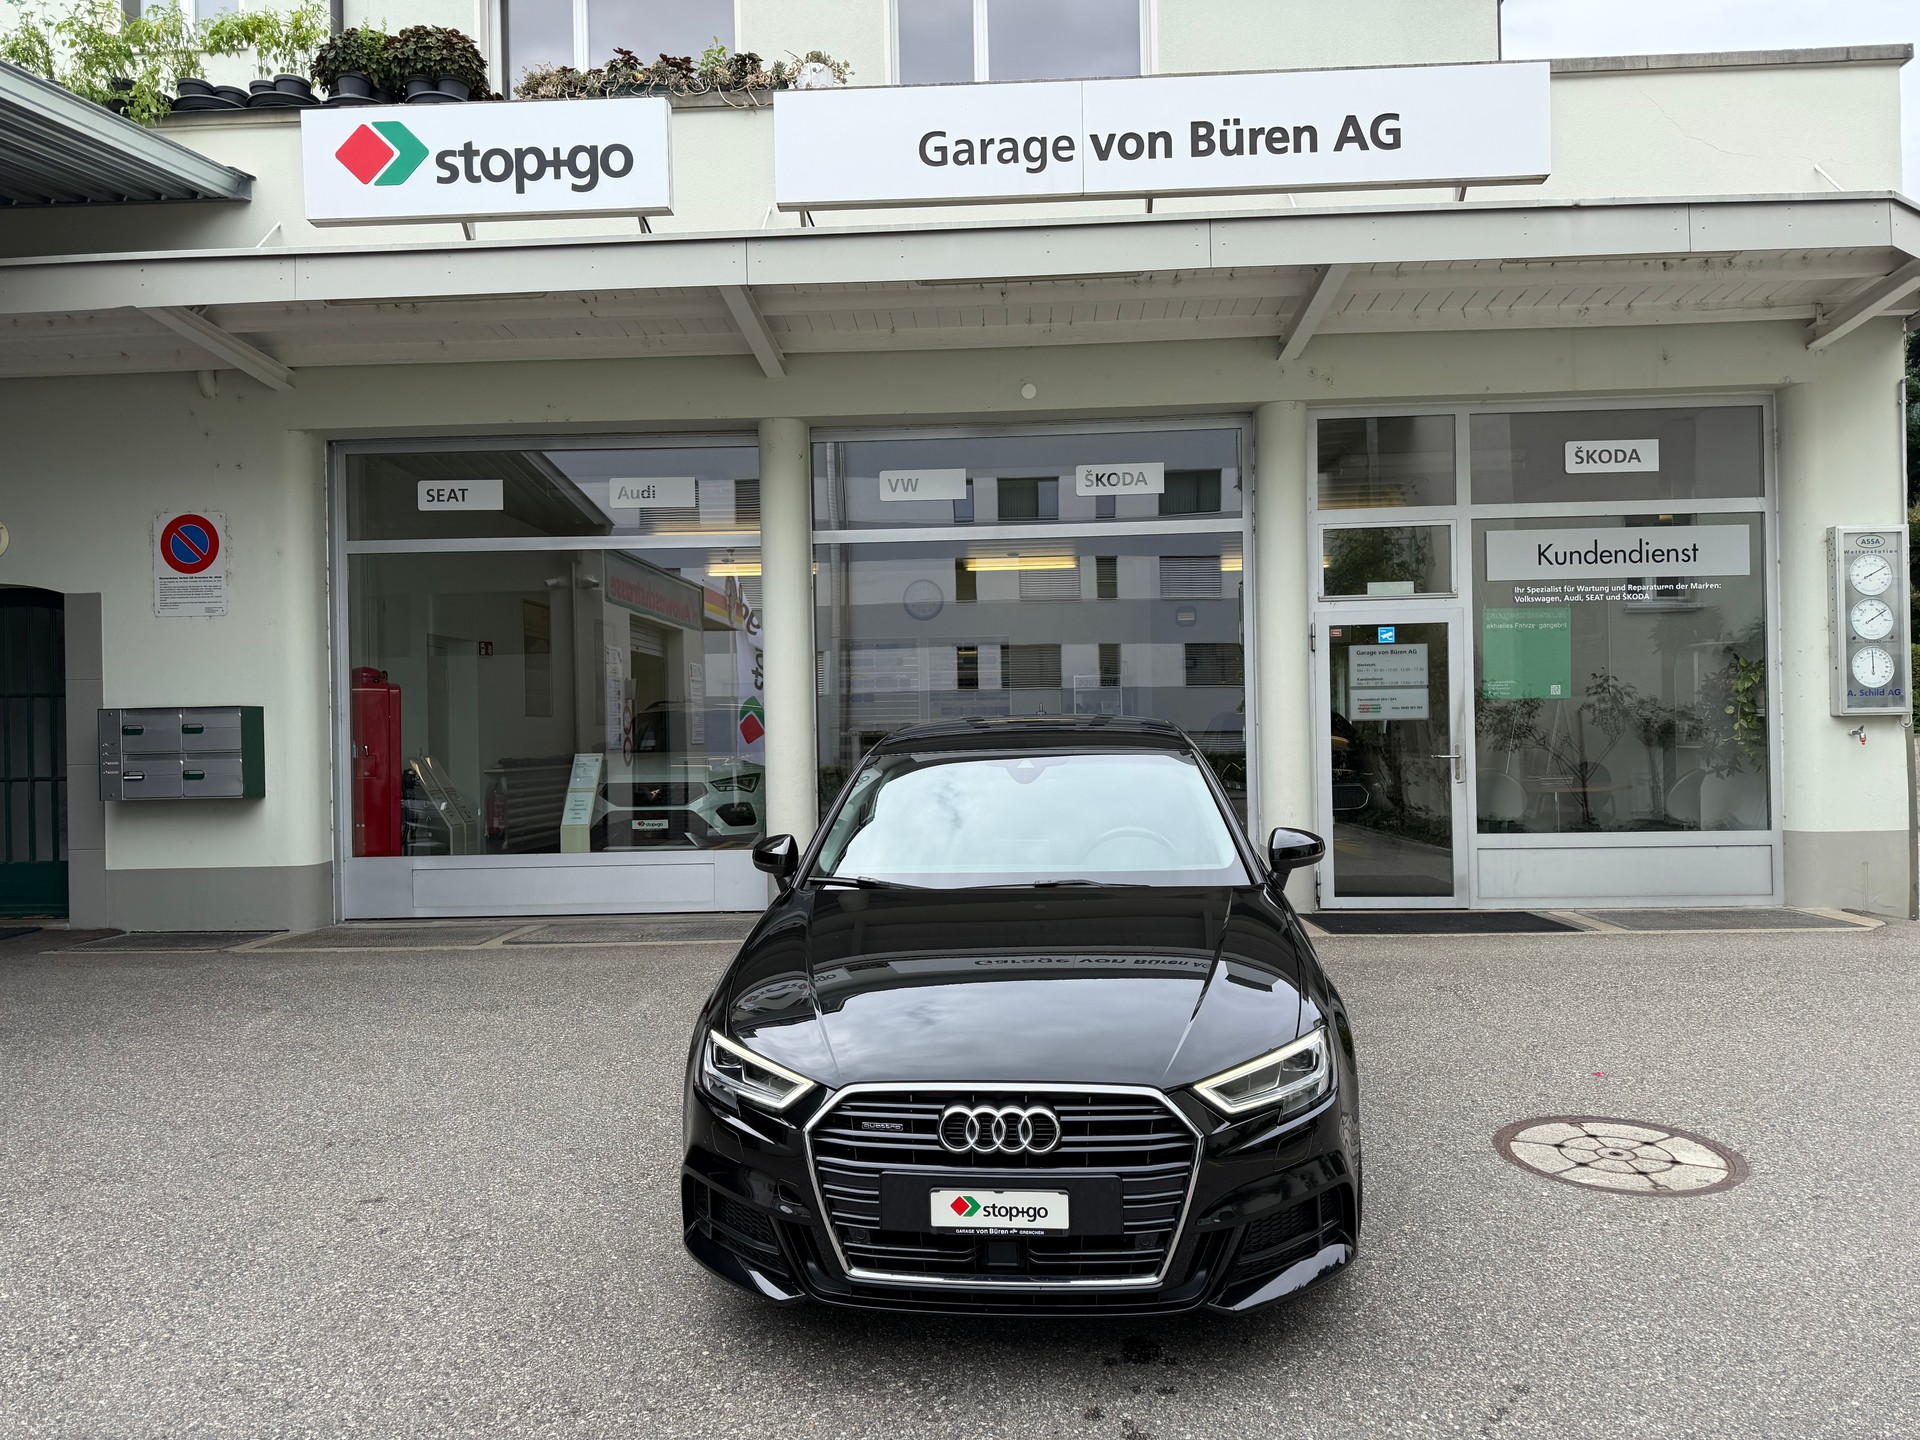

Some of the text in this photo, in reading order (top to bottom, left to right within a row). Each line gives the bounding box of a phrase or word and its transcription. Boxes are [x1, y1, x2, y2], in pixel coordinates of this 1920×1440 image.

[919, 113, 1401, 174] Garage von Büren AG
[435, 140, 634, 194] stop+go
[1574, 446, 1642, 465] ŠKODA
[887, 478, 919, 493] VW
[1084, 470, 1148, 488] ŠKODA
[426, 488, 469, 503] SEAT
[617, 485, 656, 500] Audi
[1537, 538, 1699, 566] Kundendienst
[1526, 585, 1562, 594] Spezialist
[1563, 585, 1575, 593] für
[1576, 585, 1609, 593] Wartung
[1675, 582, 1688, 590] der
[1622, 592, 1650, 601] ŠKODA
[1860, 688, 1885, 696] Schild
[982, 1203, 1048, 1222] stop+go
